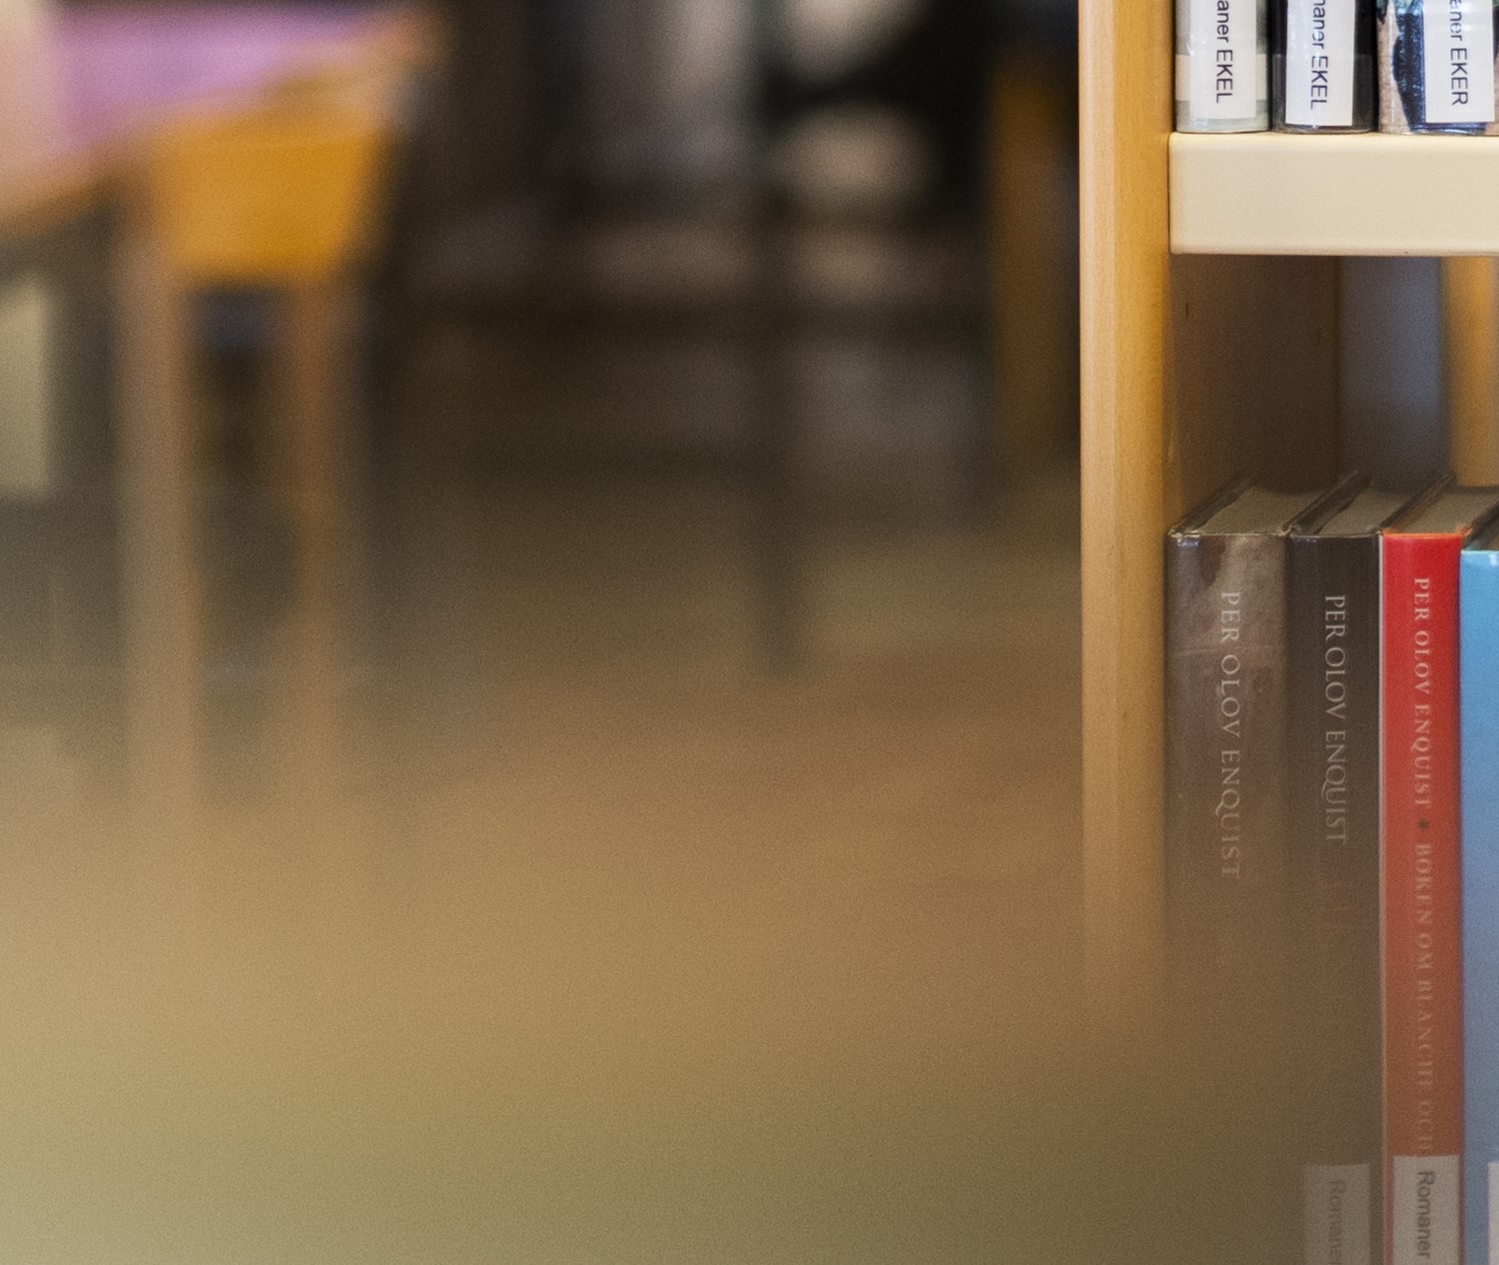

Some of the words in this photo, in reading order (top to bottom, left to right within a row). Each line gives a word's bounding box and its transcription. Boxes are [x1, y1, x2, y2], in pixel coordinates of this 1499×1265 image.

[1216, 49, 1233, 103] EKEL
[1450, 47, 1468, 105] EKER
[1414, 577, 1430, 621] PER
[1414, 630, 1430, 694] OLOV
[1411, 704, 1431, 810] ENQUIST
